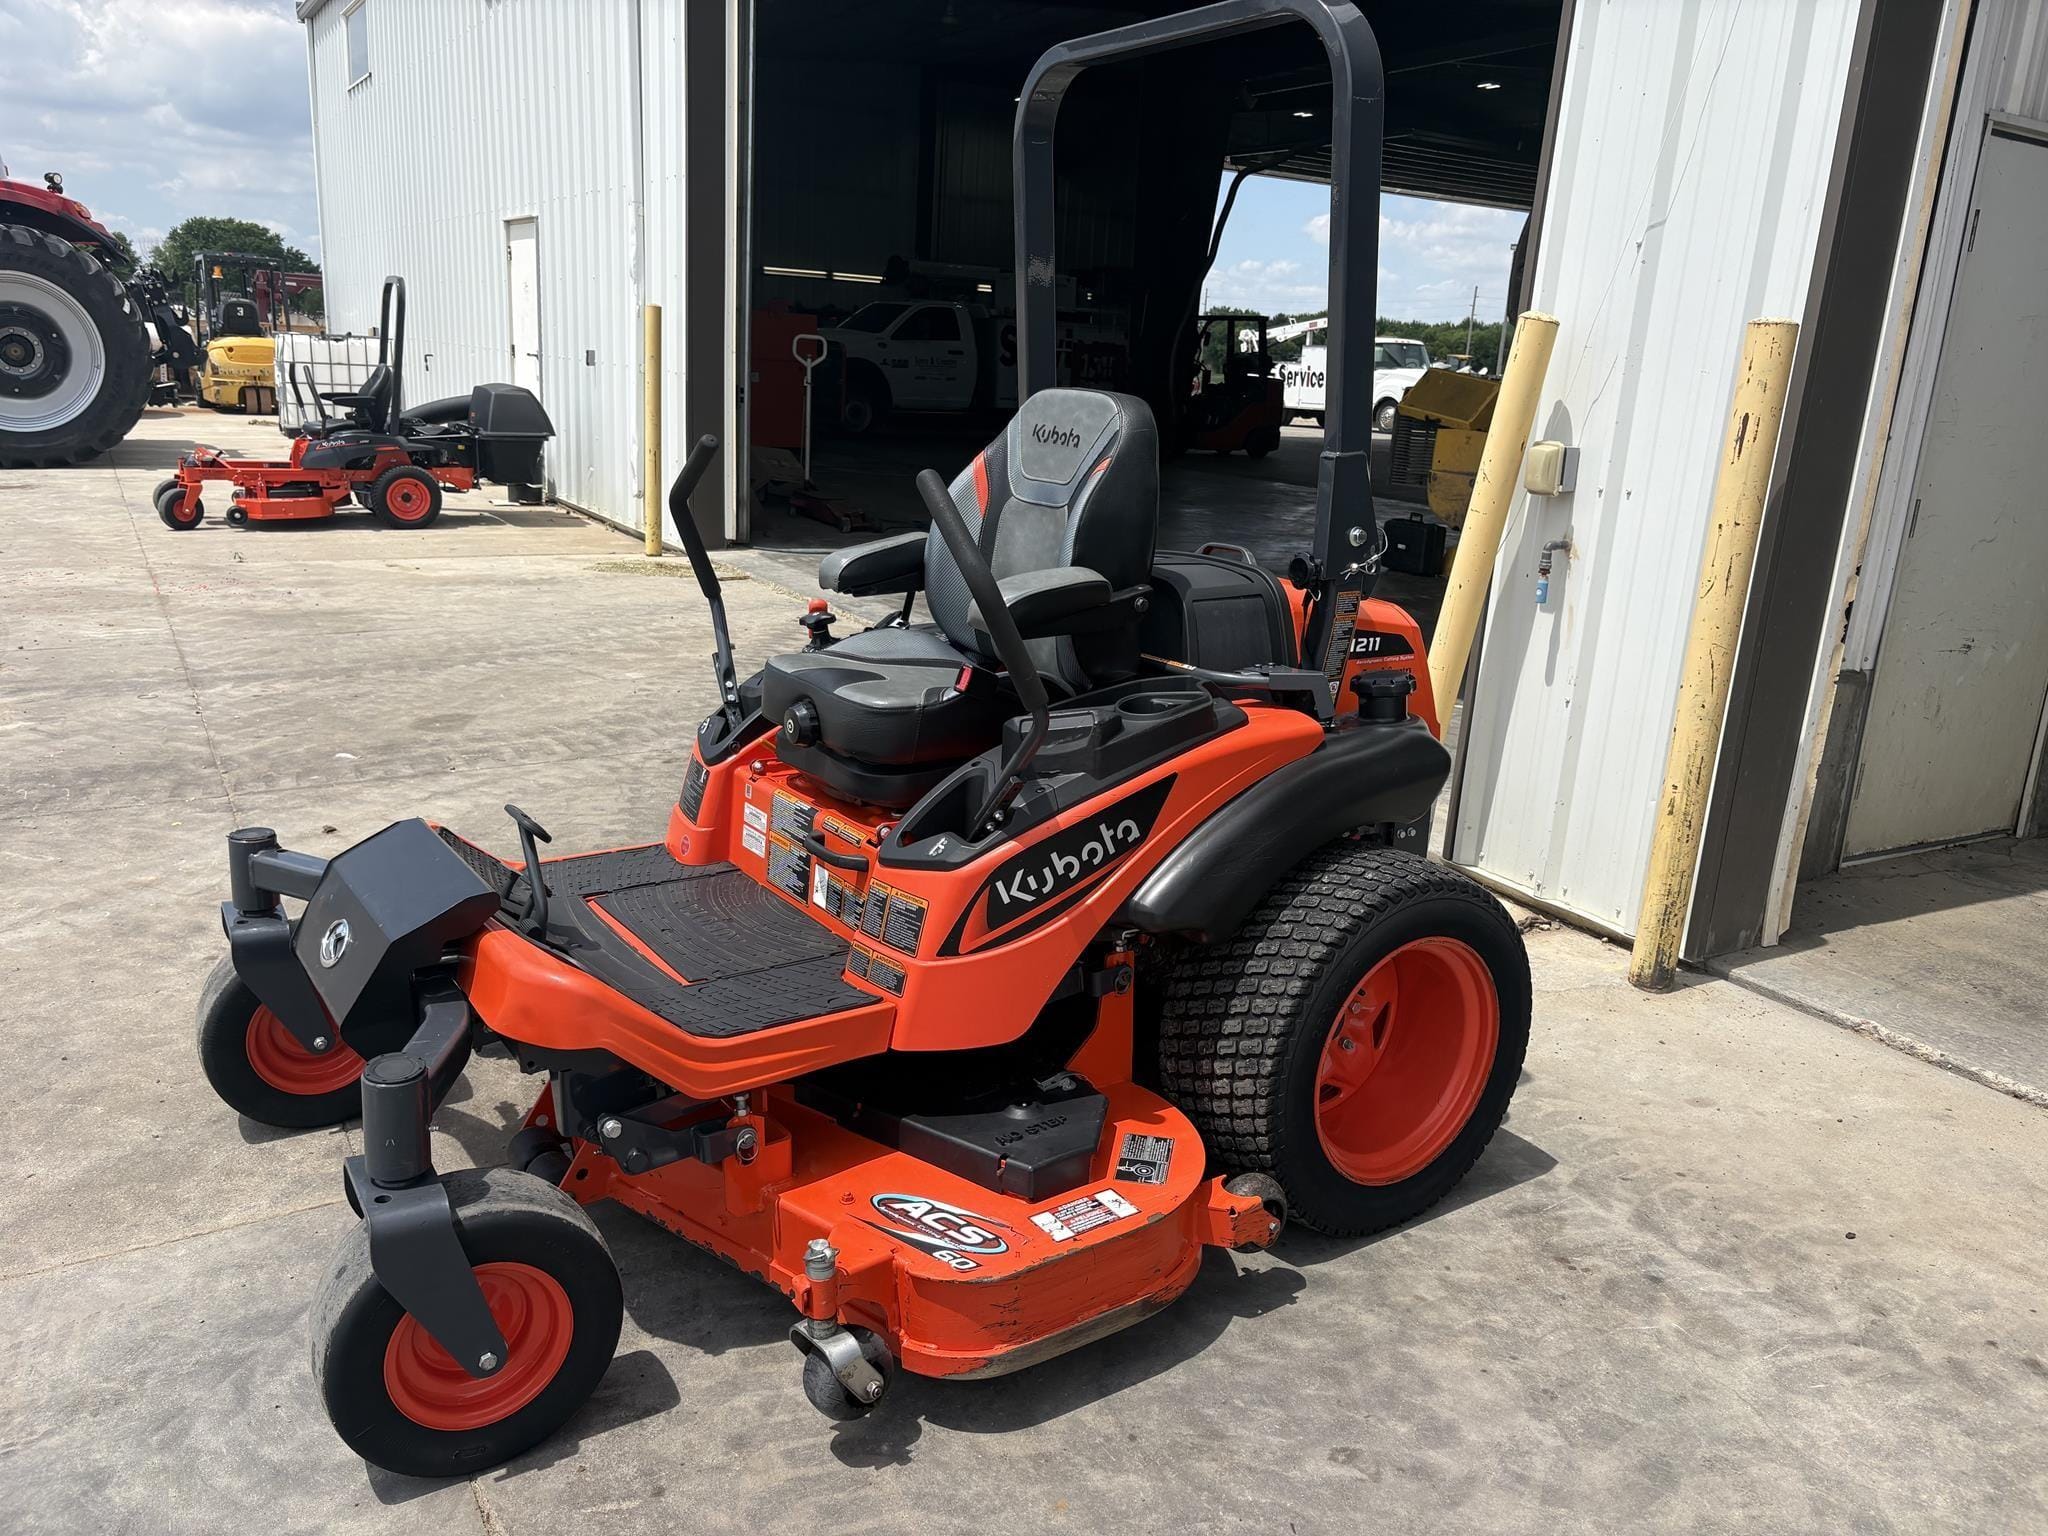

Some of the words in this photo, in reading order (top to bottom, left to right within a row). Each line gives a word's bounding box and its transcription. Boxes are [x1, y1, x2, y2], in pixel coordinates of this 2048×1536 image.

[236, 306, 244, 317] 3
[1278, 364, 1325, 388] Service
[1032, 423, 1080, 449] Kubota
[995, 819, 1141, 905] Kubota
[994, 1130, 1023, 1146] NO
[1025, 1115, 1067, 1136] STEP
[887, 1200, 997, 1245] ACS
[932, 1249, 978, 1270] 60
